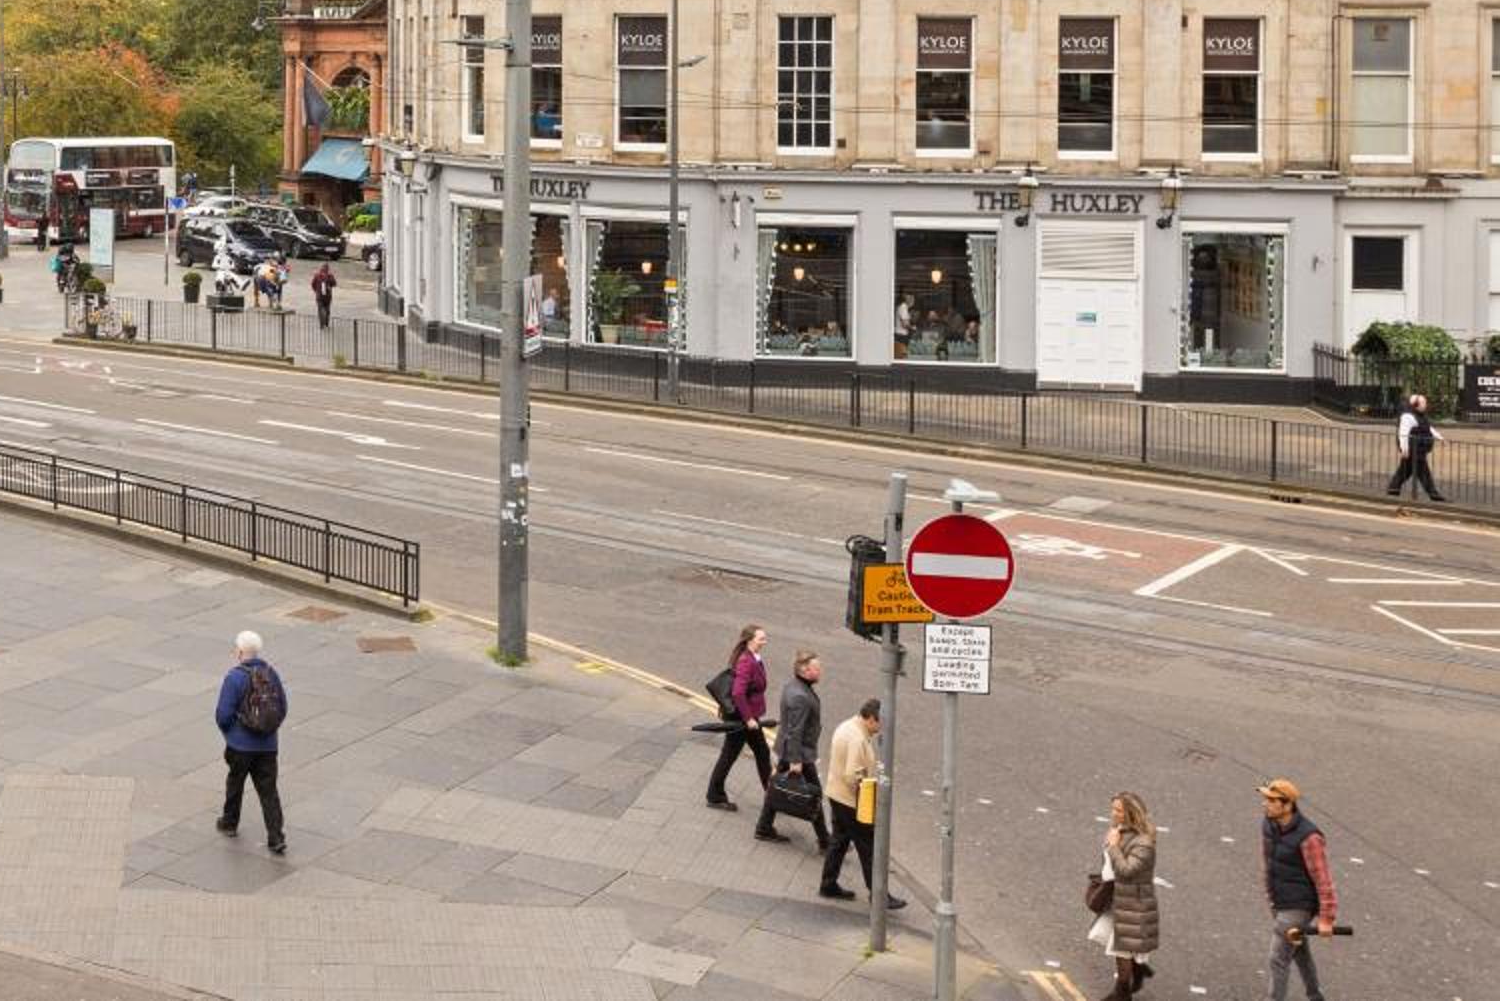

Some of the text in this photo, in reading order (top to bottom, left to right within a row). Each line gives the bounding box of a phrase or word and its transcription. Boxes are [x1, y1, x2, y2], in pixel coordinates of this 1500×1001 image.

[621, 34, 664, 46] KYLOE
[920, 36, 967, 48] KYLOE
[1061, 36, 1108, 48] KYLOE
[1206, 36, 1253, 49] KYLOE
[974, 190, 1145, 213] THE HUXLEY
[878, 590, 916, 601] Cautio
